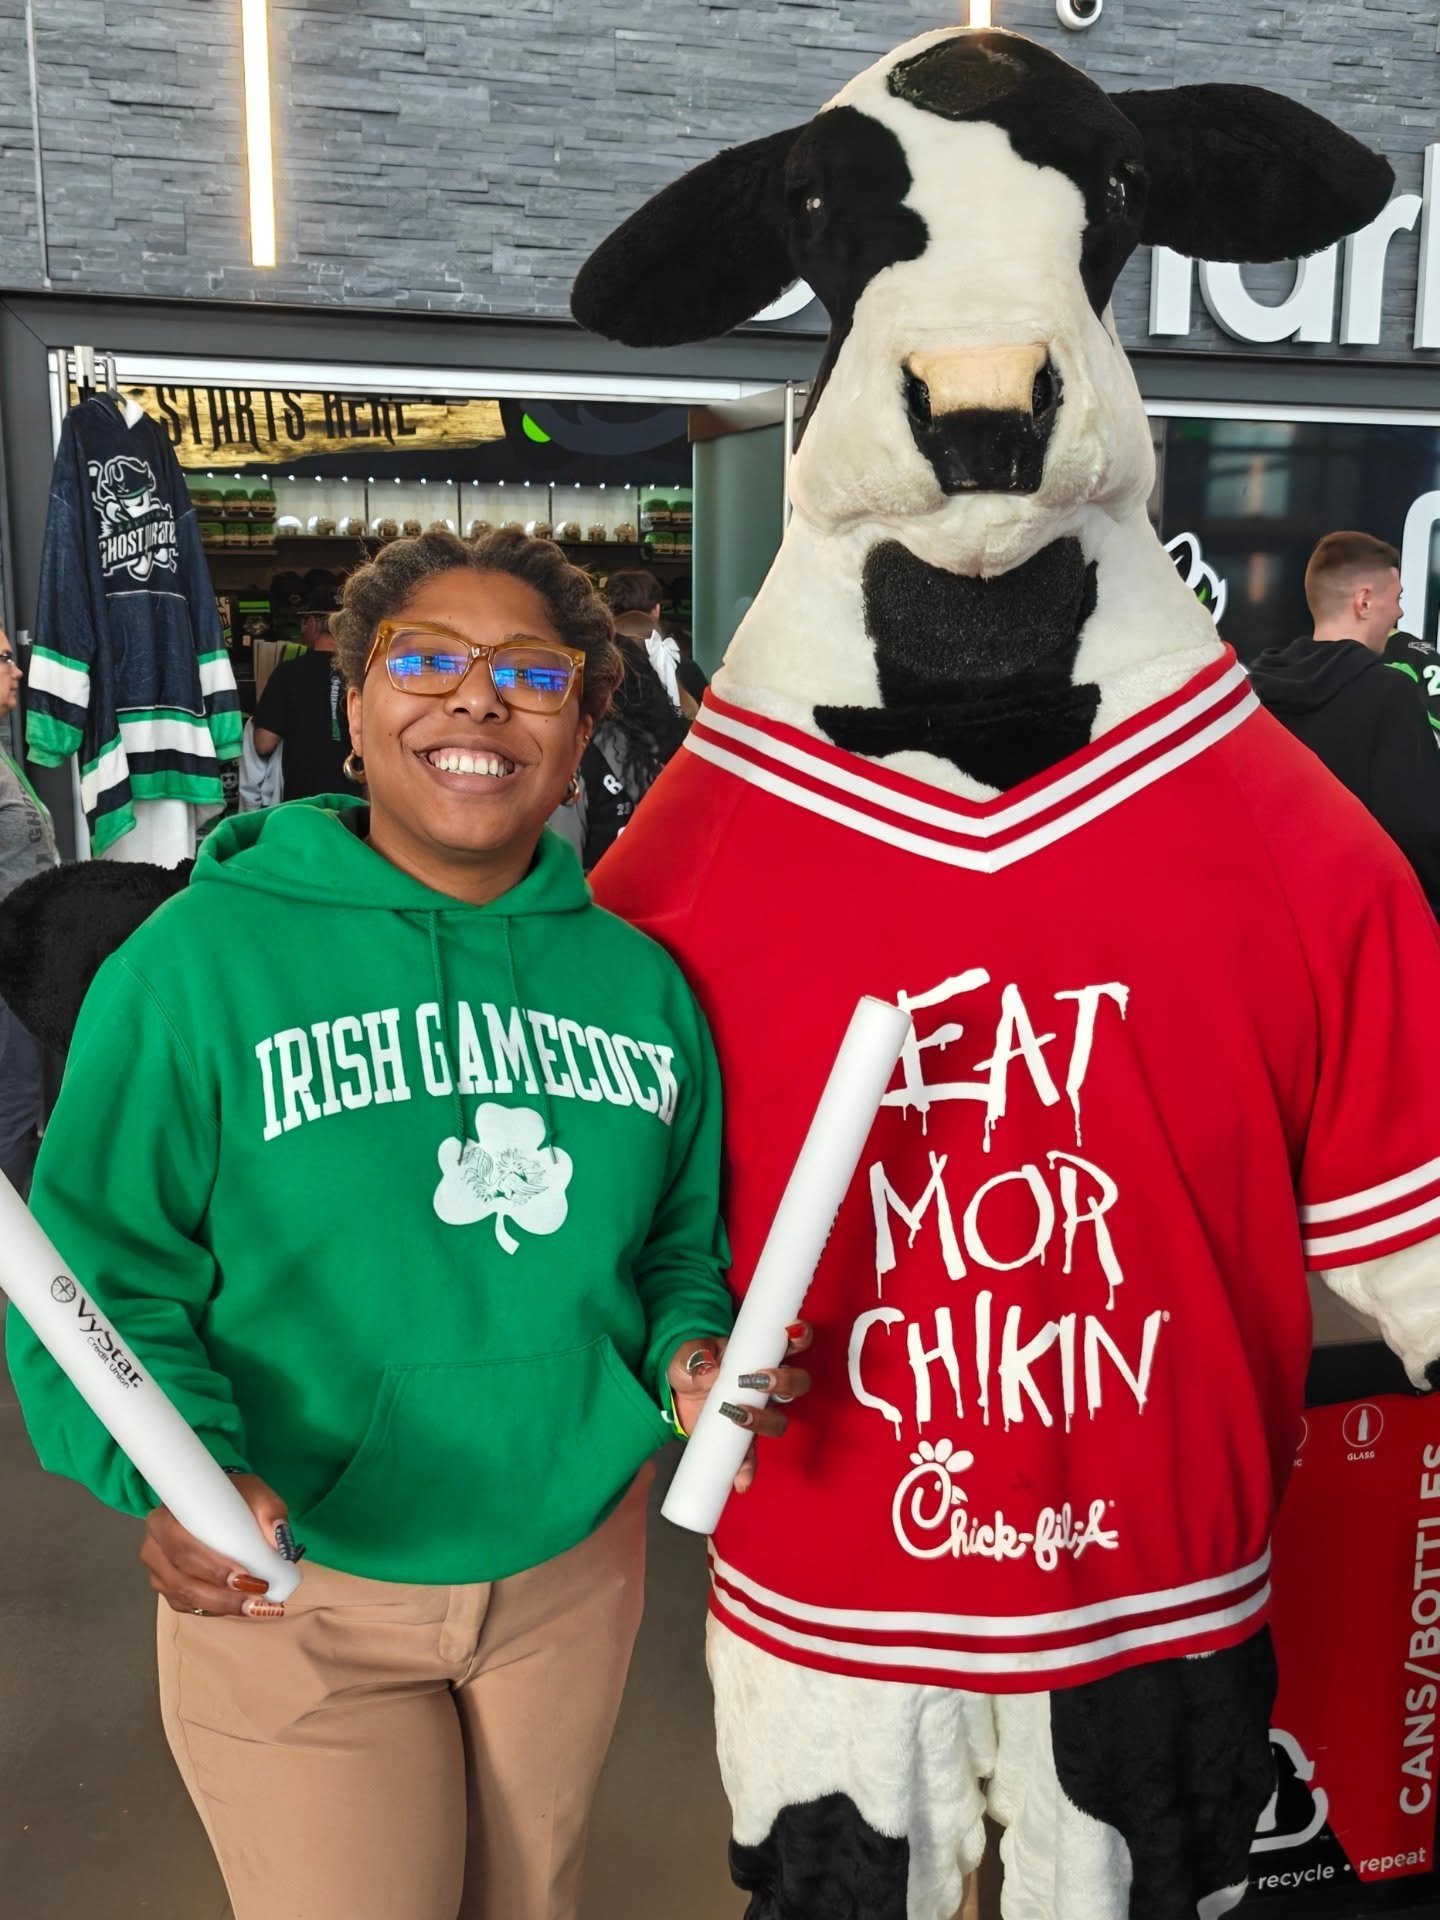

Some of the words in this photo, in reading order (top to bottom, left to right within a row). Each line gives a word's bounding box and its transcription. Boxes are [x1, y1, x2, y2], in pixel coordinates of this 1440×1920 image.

[255, 1007, 411, 1141] IRISH
[415, 1001, 679, 1126] GAMECOCK
[880, 968, 1129, 1152] EAT
[869, 1151, 1124, 1310] MOR
[87, 1336, 110, 1363] Credit
[109, 1363, 130, 1389] Union
[848, 1290, 1162, 1441] CHIKIN
[892, 1439, 1119, 1571] Chick-fil-A
[1347, 1450, 1376, 1461] GLASS
[1258, 1864, 1335, 1889] recycle
[1359, 1848, 1426, 1872] repeat
